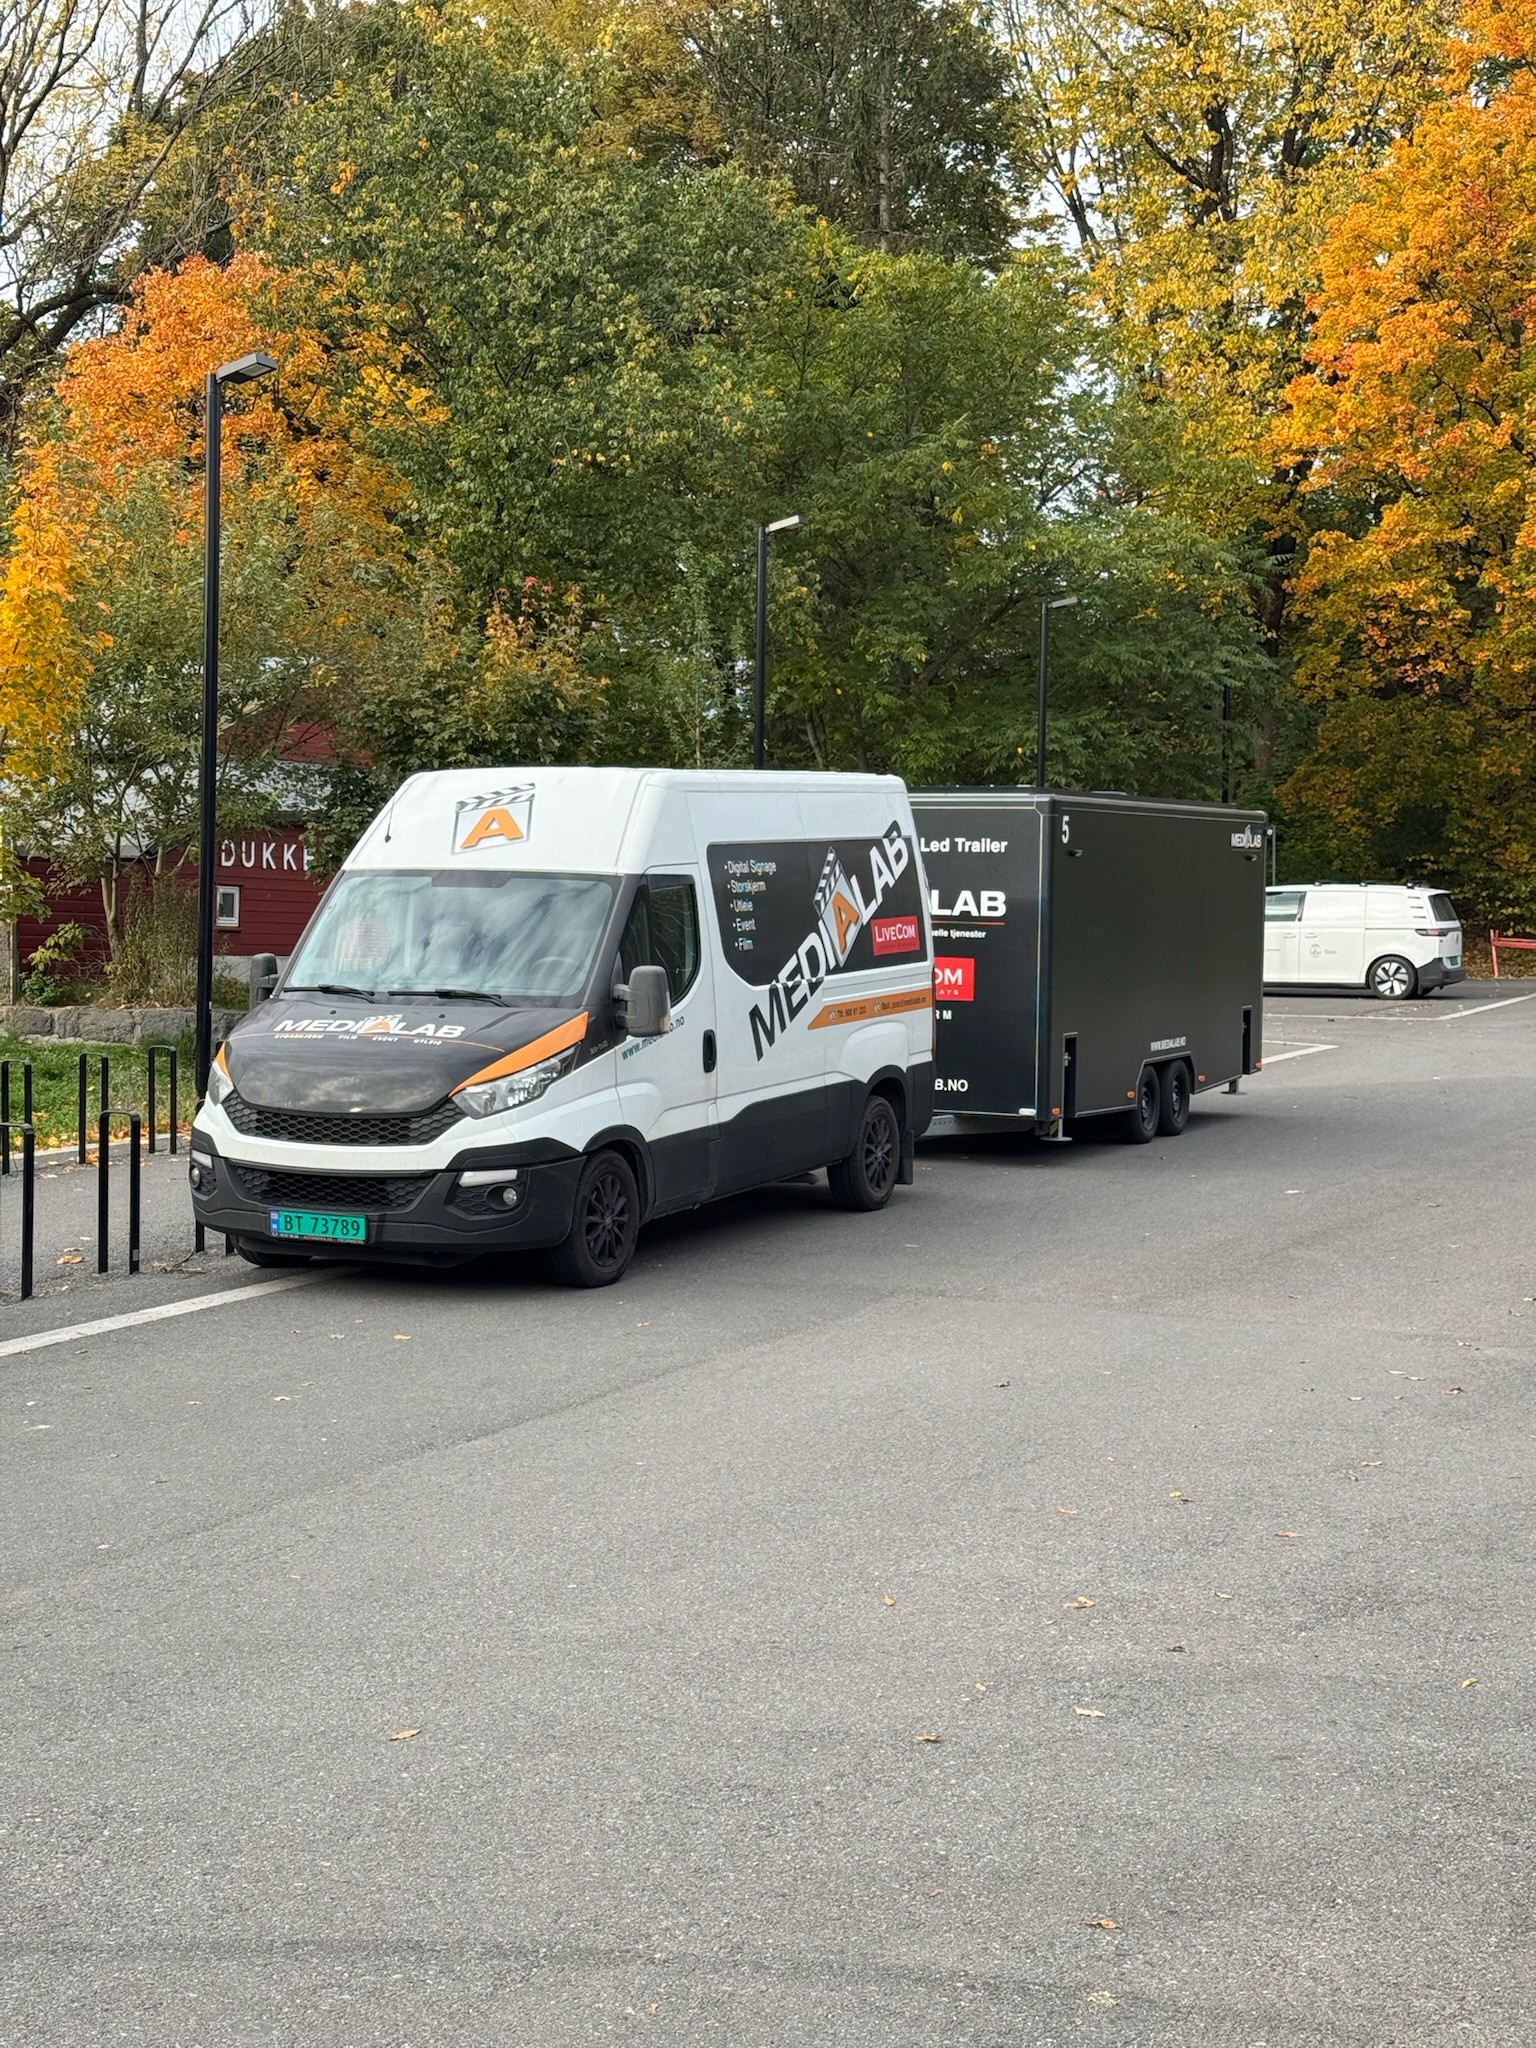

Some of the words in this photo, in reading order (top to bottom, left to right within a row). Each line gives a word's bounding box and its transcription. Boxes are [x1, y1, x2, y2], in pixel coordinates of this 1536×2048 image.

[1062, 815, 1070, 844] 5
[920, 837, 950, 853] Led
[954, 837, 1008, 853] Trailer
[727, 860, 750, 877] Digital
[750, 859, 777, 876] Signage
[730, 879, 767, 895] Storskjerm
[930, 889, 1007, 917] LAB
[736, 918, 756, 932] Event
[950, 928, 987, 939] tjenester
[738, 937, 754, 951] Film
[749, 820, 909, 1062] MEDIALAB
[273, 1015, 466, 1038] MEDIALAB
[284, 1214, 303, 1233] BT
[310, 1217, 360, 1237] 73789
